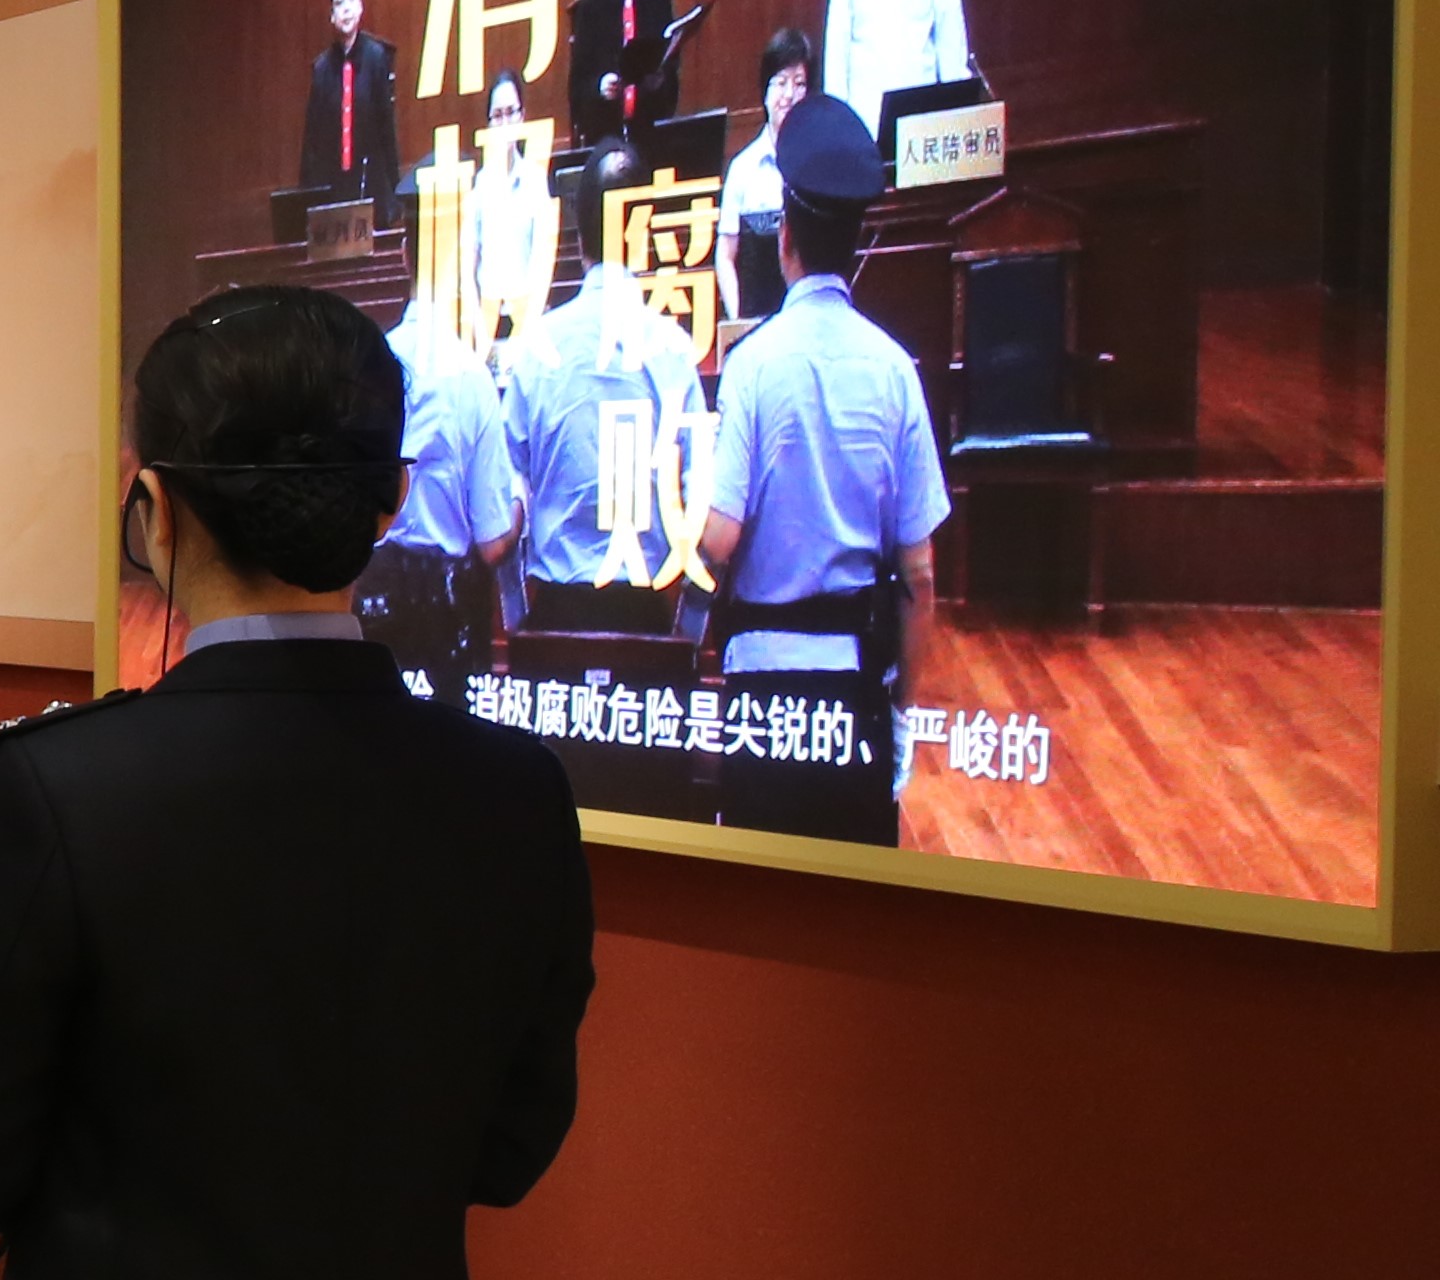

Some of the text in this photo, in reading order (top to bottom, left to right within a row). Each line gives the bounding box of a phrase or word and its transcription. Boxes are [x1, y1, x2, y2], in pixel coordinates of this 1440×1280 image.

[902, 126, 1001, 167] 人民陪审员
[465, 673, 1050, 786] 消极腐败危险是尖锐的、严峻的
